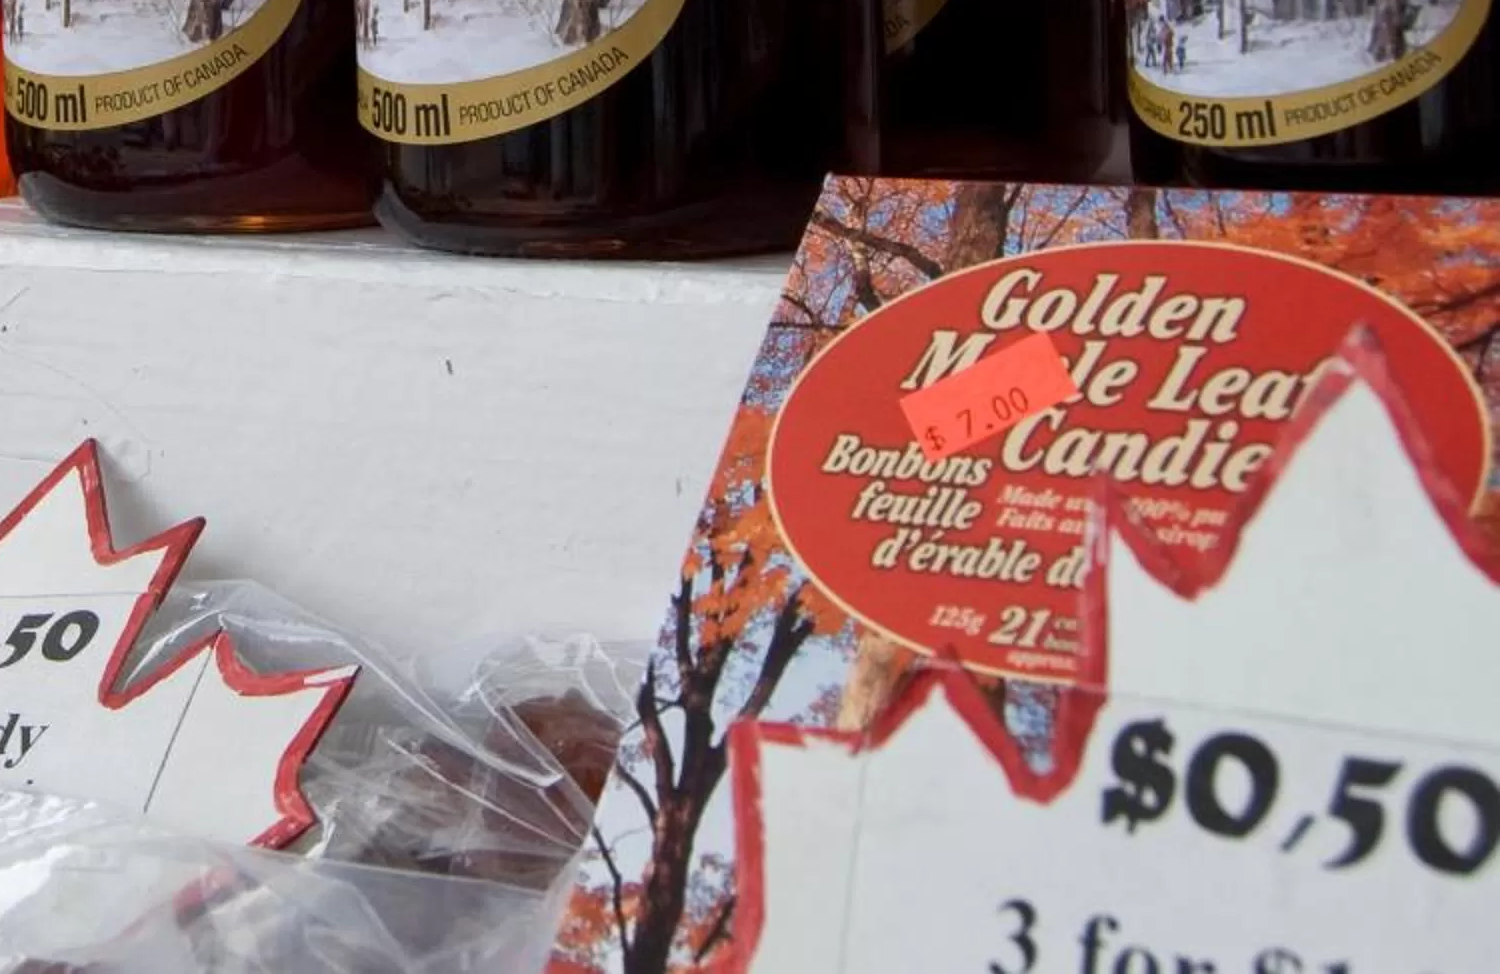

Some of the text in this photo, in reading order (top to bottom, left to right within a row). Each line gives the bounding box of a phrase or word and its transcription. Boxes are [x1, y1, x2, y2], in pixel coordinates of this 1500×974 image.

[16, 43, 248, 124] 500 ml PRODUCT OF CANADA
[372, 86, 407, 135] 500
[415, 93, 450, 137] ml
[459, 90, 533, 126] PRODUCT
[535, 81, 557, 107] OF
[556, 46, 630, 98] CANADA
[1178, 100, 1227, 140] 250
[1236, 99, 1277, 140] ml
[1284, 94, 1357, 127] PRODUCT
[1360, 83, 1381, 106] OF
[1378, 50, 1442, 97] CANADA
[981, 267, 1247, 344] Golden
[900, 329, 1139, 409] Mle
[925, 387, 1029, 451] $ 7.00
[1002, 404, 1276, 494] Candie
[821, 433, 993, 487] Bonbons
[997, 483, 1063, 509] Made
[851, 480, 984, 530] feuille
[871, 528, 1042, 583] d'érable
[986, 604, 1052, 648] 21
[987, 899, 1039, 974] 3
